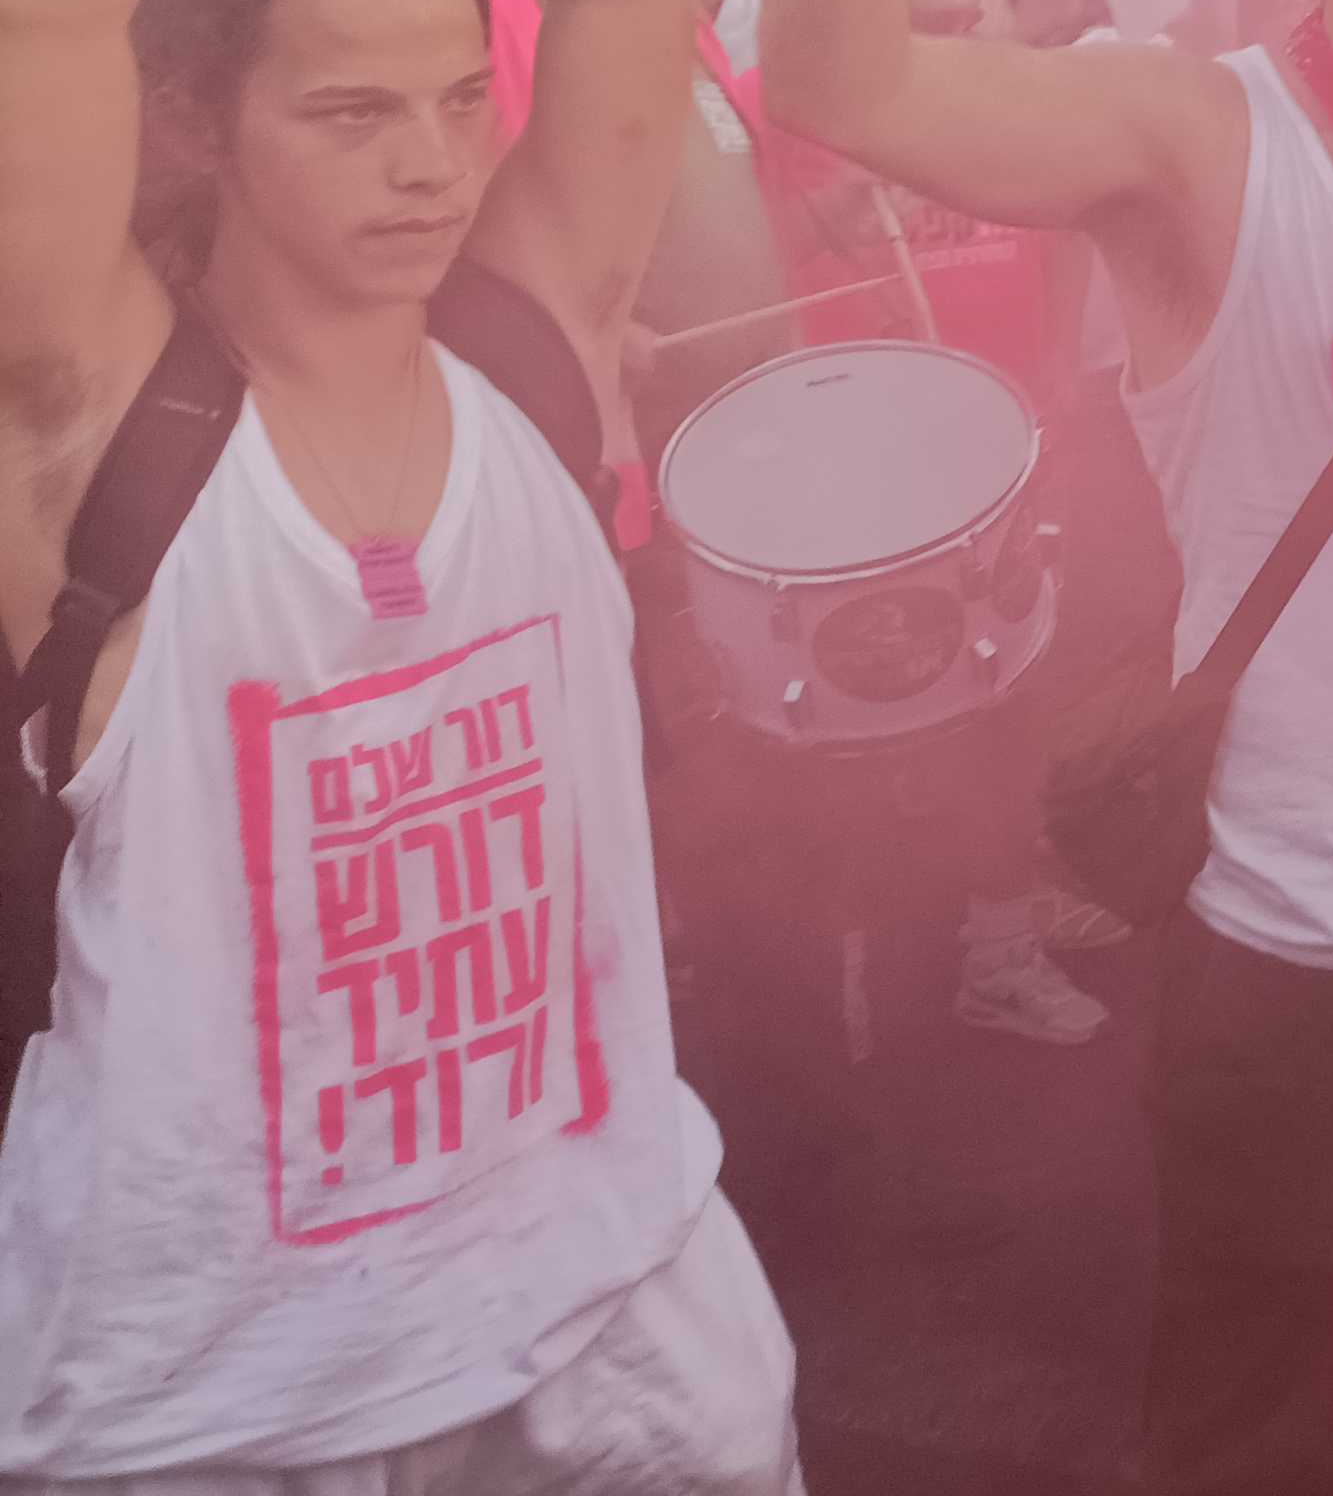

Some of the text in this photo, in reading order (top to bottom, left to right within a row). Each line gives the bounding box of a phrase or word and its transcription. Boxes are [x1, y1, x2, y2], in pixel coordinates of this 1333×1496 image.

[307, 682, 535, 825] דור שלם
[314, 782, 547, 962] דורש
[316, 895, 552, 1067] עתיד
[317, 1004, 549, 1187] ורוד!
